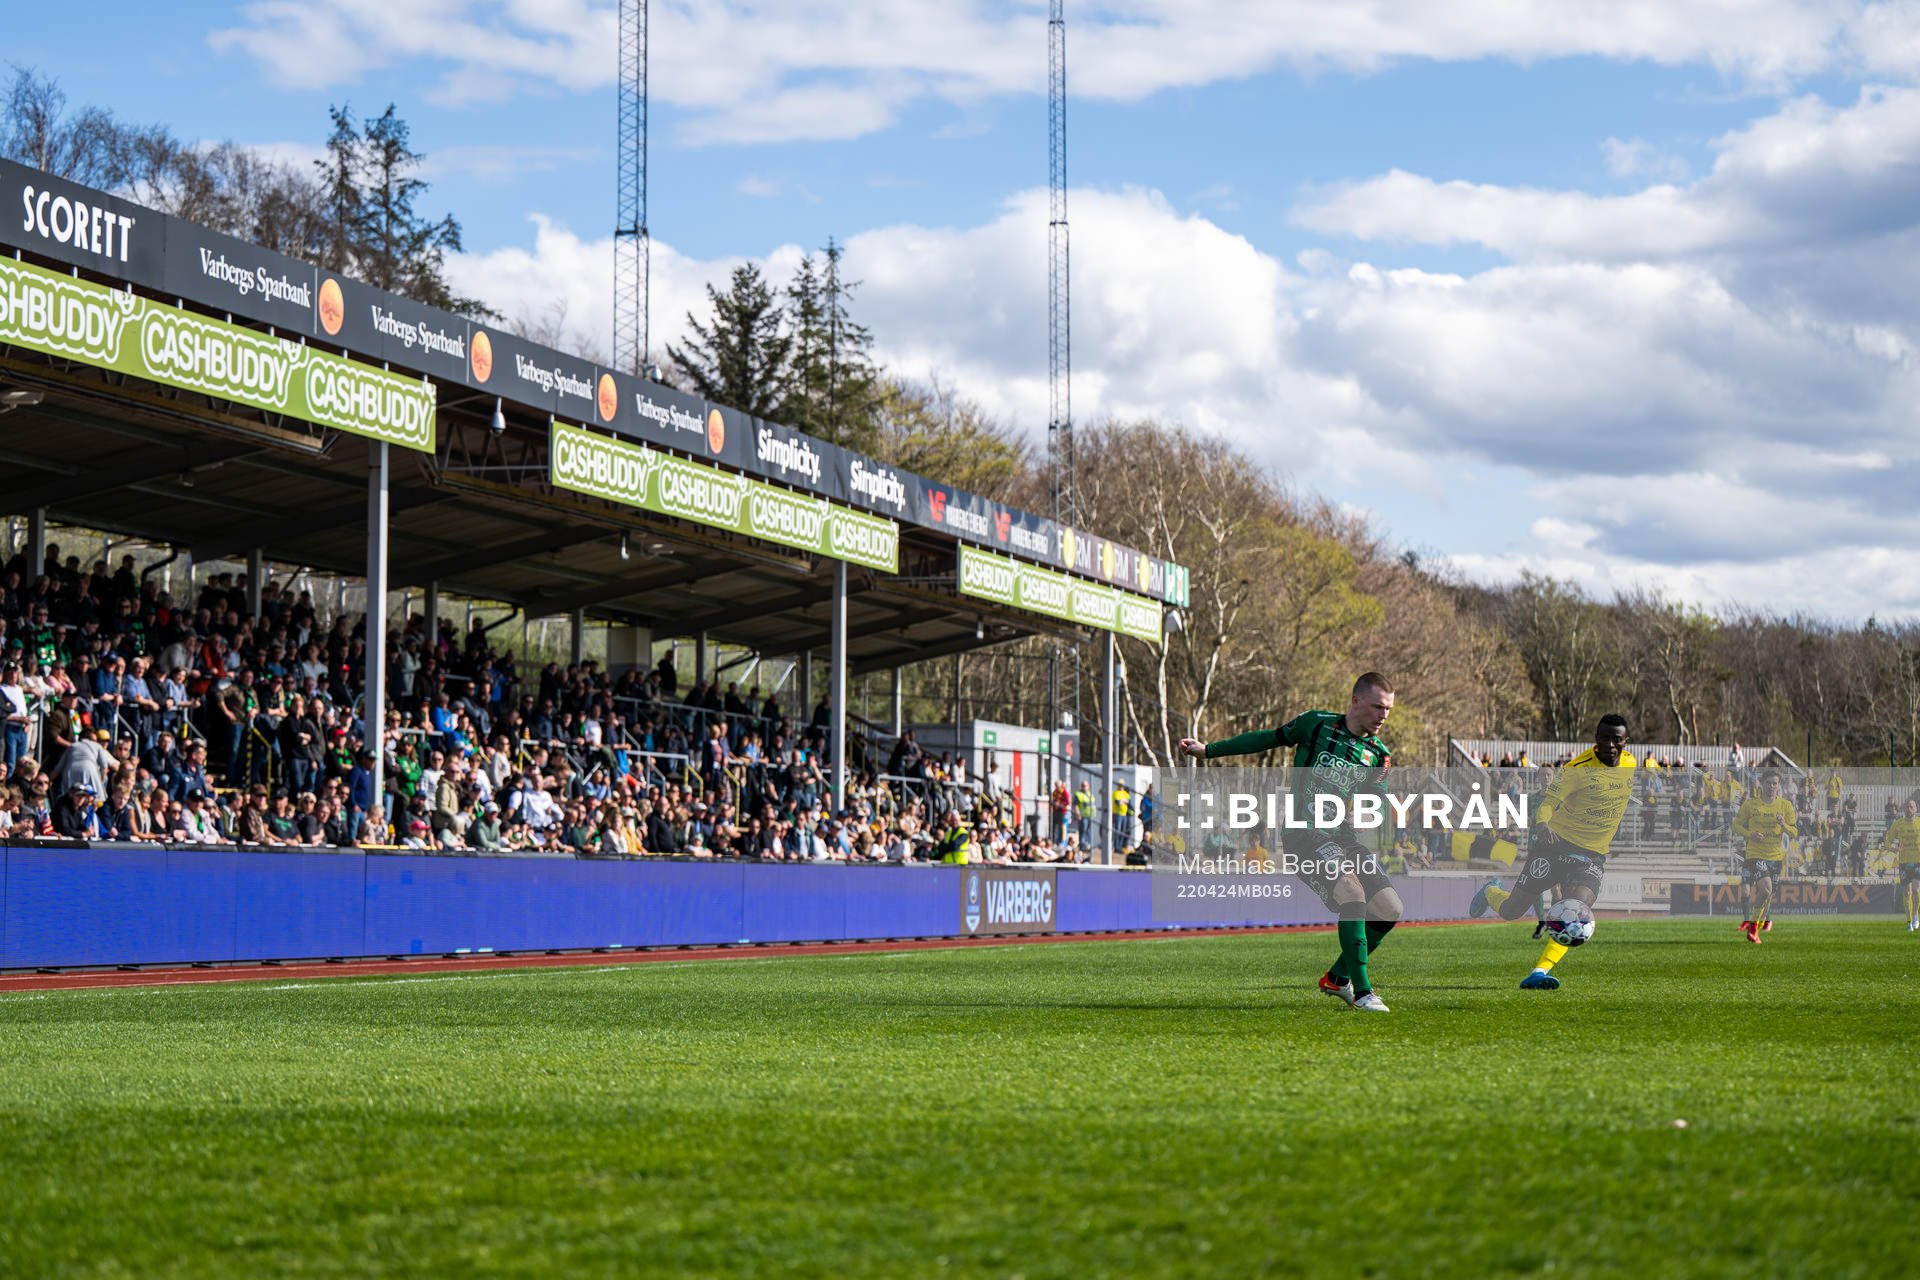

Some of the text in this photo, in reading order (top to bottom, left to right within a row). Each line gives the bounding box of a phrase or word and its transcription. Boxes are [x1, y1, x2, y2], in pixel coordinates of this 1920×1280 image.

[23, 185, 133, 262] SCORETT
[200, 247, 311, 308] Varbergs Sparbank
[371, 305, 465, 359] Varbergs Sparbank
[147, 320, 287, 396] CASHBUDDY
[515, 354, 593, 401] Varbergs Sparbank
[310, 368, 430, 435] CASHBUDDY
[636, 393, 704, 435] Varbergs Sparbank
[557, 440, 647, 494] CASHBUDDY
[661, 469, 740, 519] CASHBUDDY
[753, 494, 823, 540] CASHBUDDY
[832, 518, 895, 561] CASHBUDDY
[1315, 764, 1355, 789] BUDDY
[1320, 754, 1352, 775] CASH
[986, 880, 1053, 924] VARBERG
